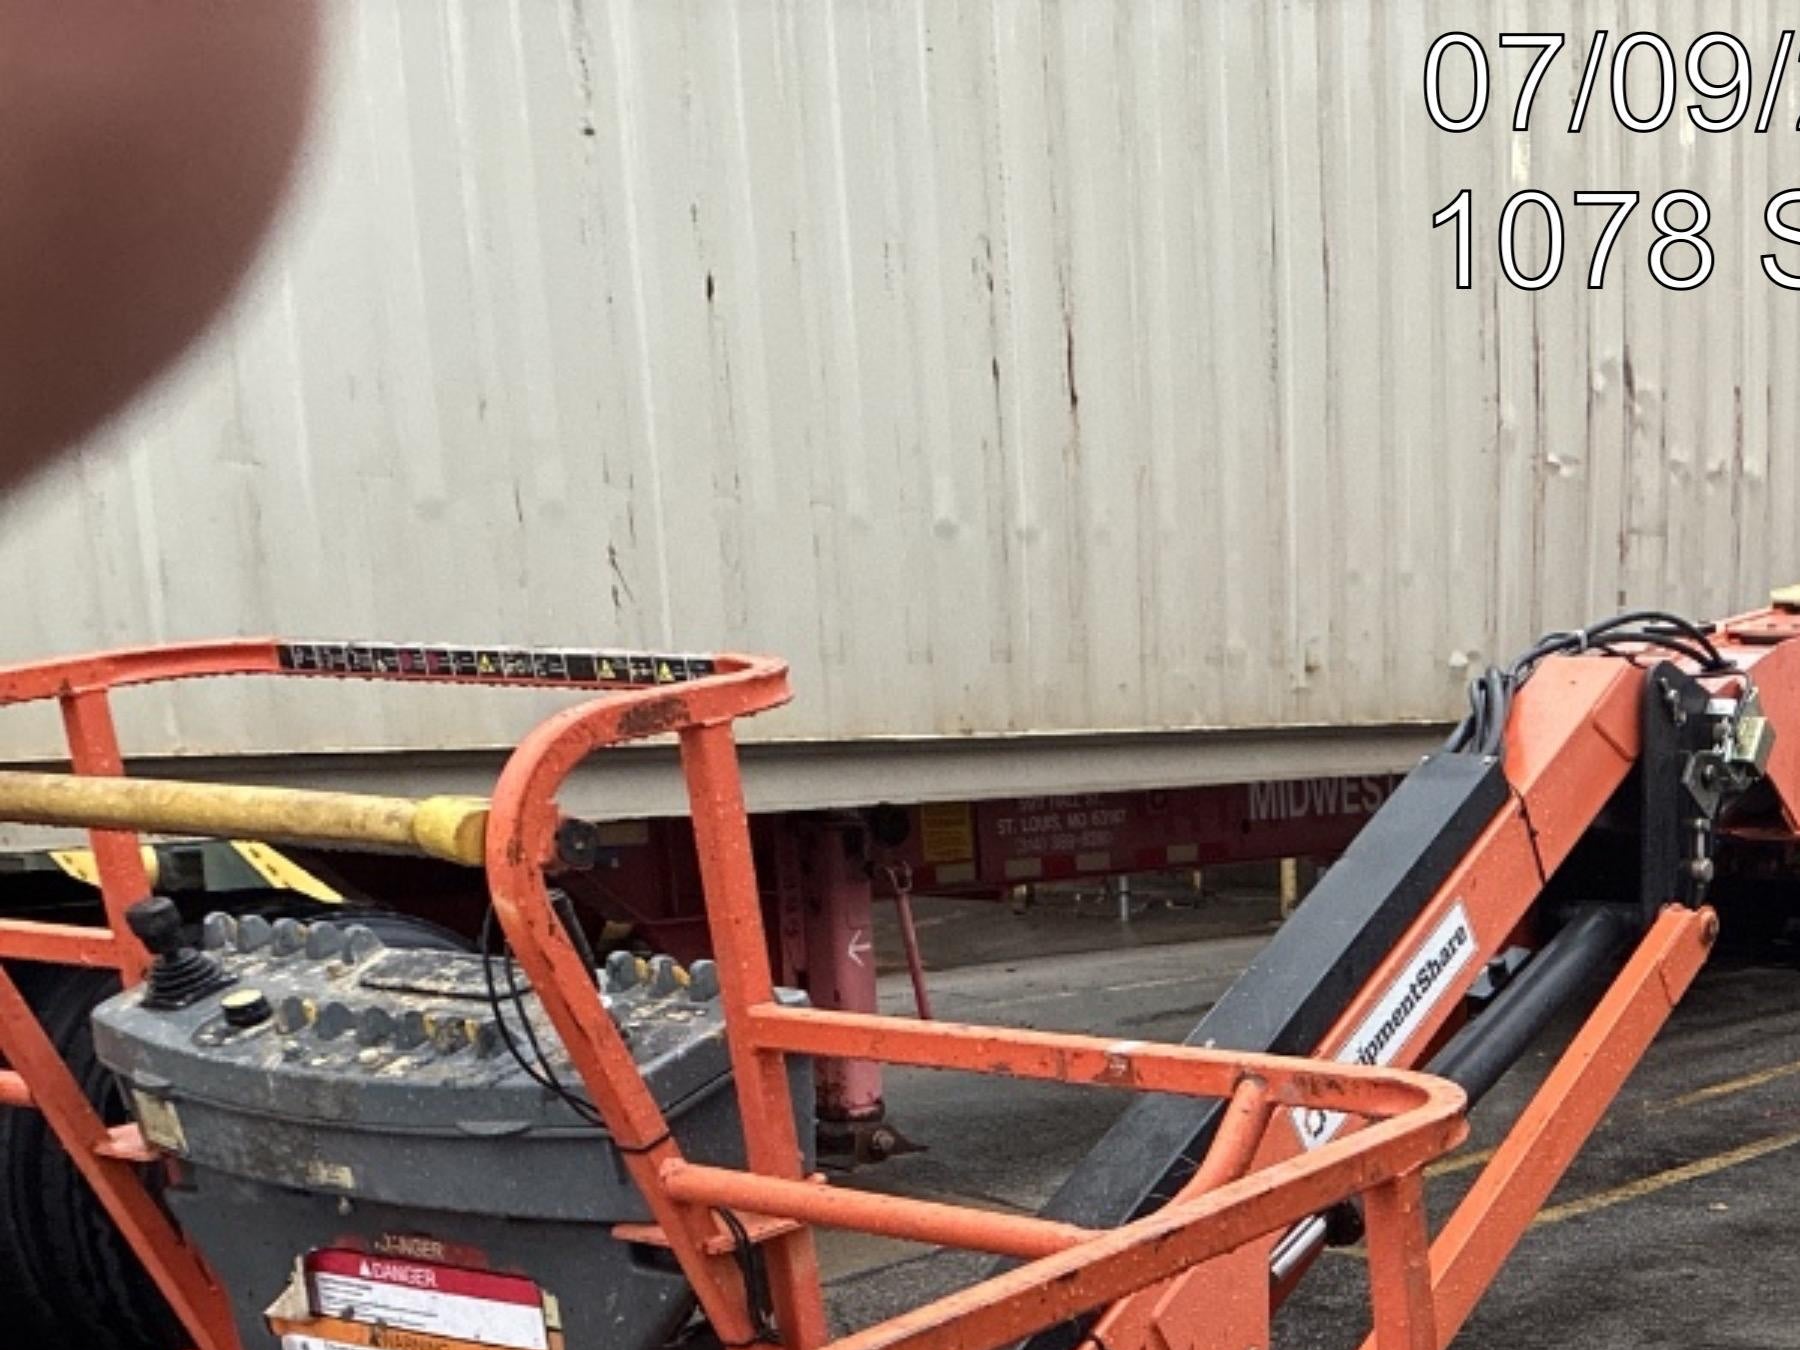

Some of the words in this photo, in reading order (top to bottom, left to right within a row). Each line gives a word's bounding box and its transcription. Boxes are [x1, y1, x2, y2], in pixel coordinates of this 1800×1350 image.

[1067, 811, 1087, 828] MO
[1354, 925, 1468, 1067] ipmentShare
[372, 1262, 439, 1289] DANGER
